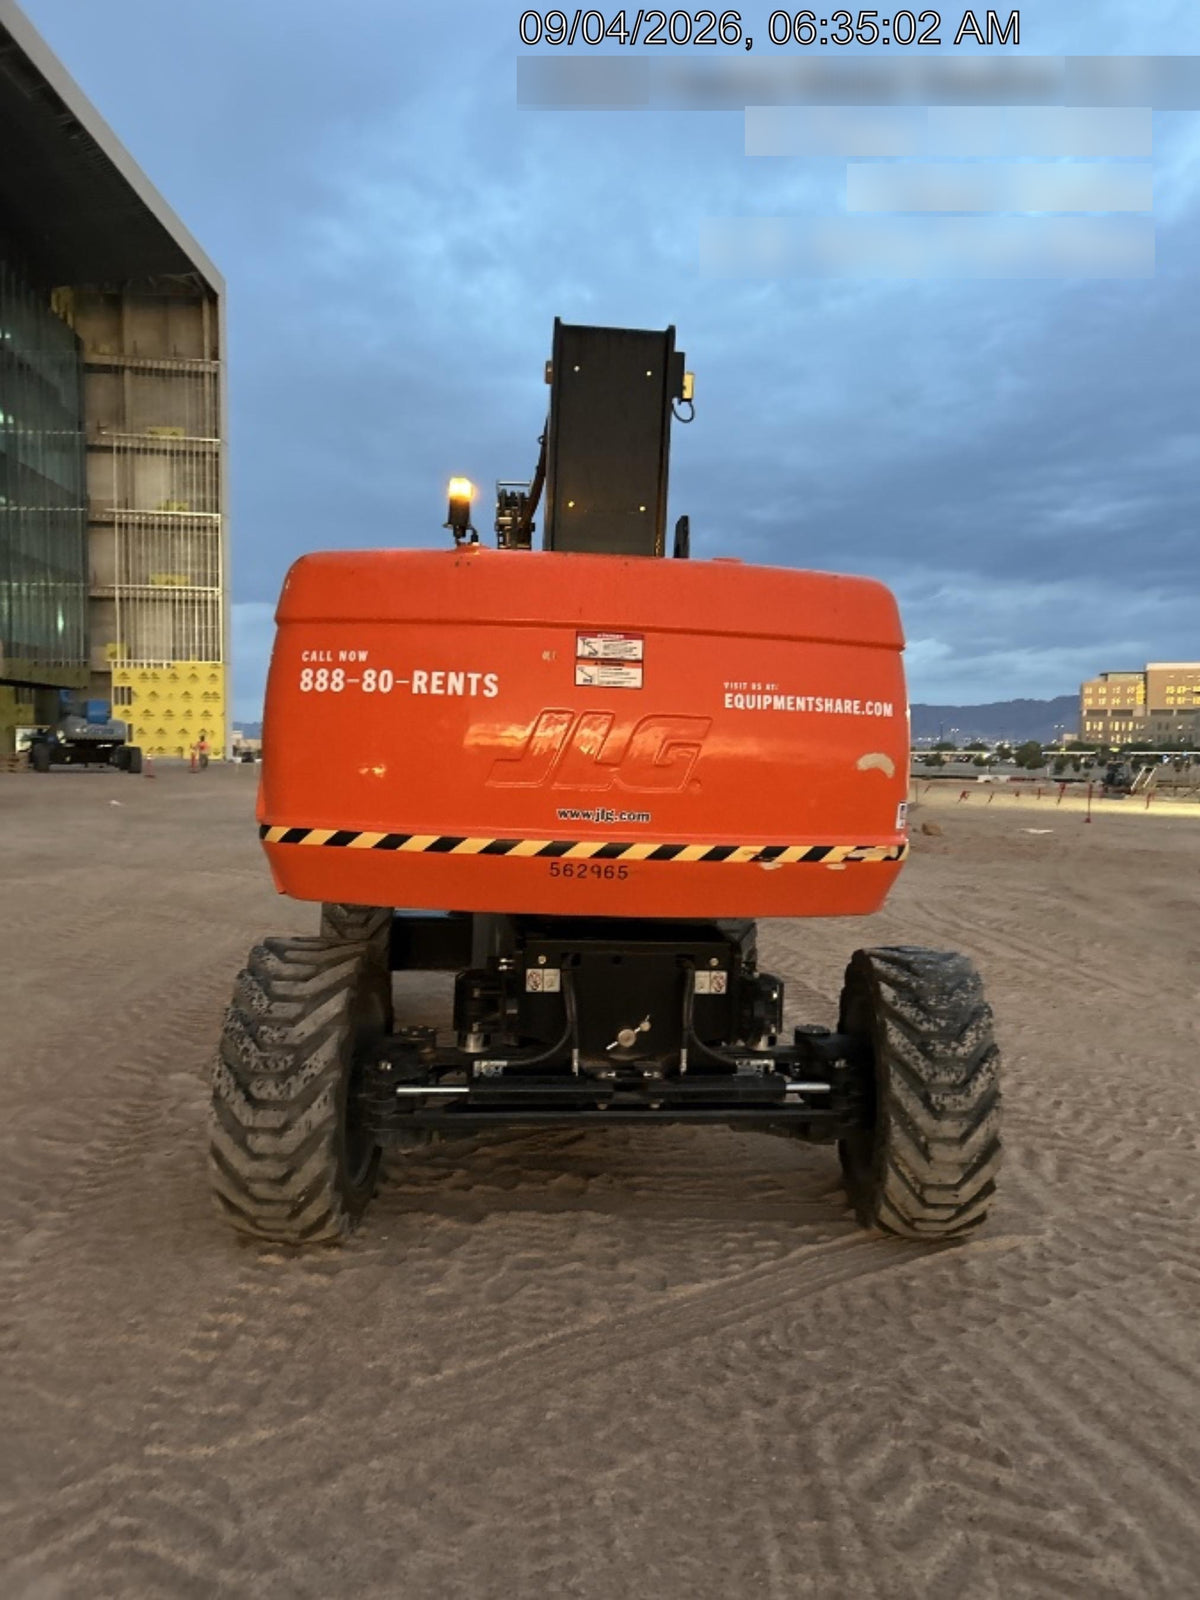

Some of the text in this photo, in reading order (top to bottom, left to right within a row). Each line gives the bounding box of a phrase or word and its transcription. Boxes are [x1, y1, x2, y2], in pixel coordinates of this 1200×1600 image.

[301, 650, 369, 662] CALL NOW
[300, 668, 499, 698] 888-80-RENTS
[724, 693, 894, 717] EQUIPMENTSHARE.COM
[485, 707, 713, 793] JLG
[556, 808, 651, 823] www.jlg.com
[549, 862, 629, 880] 562965
